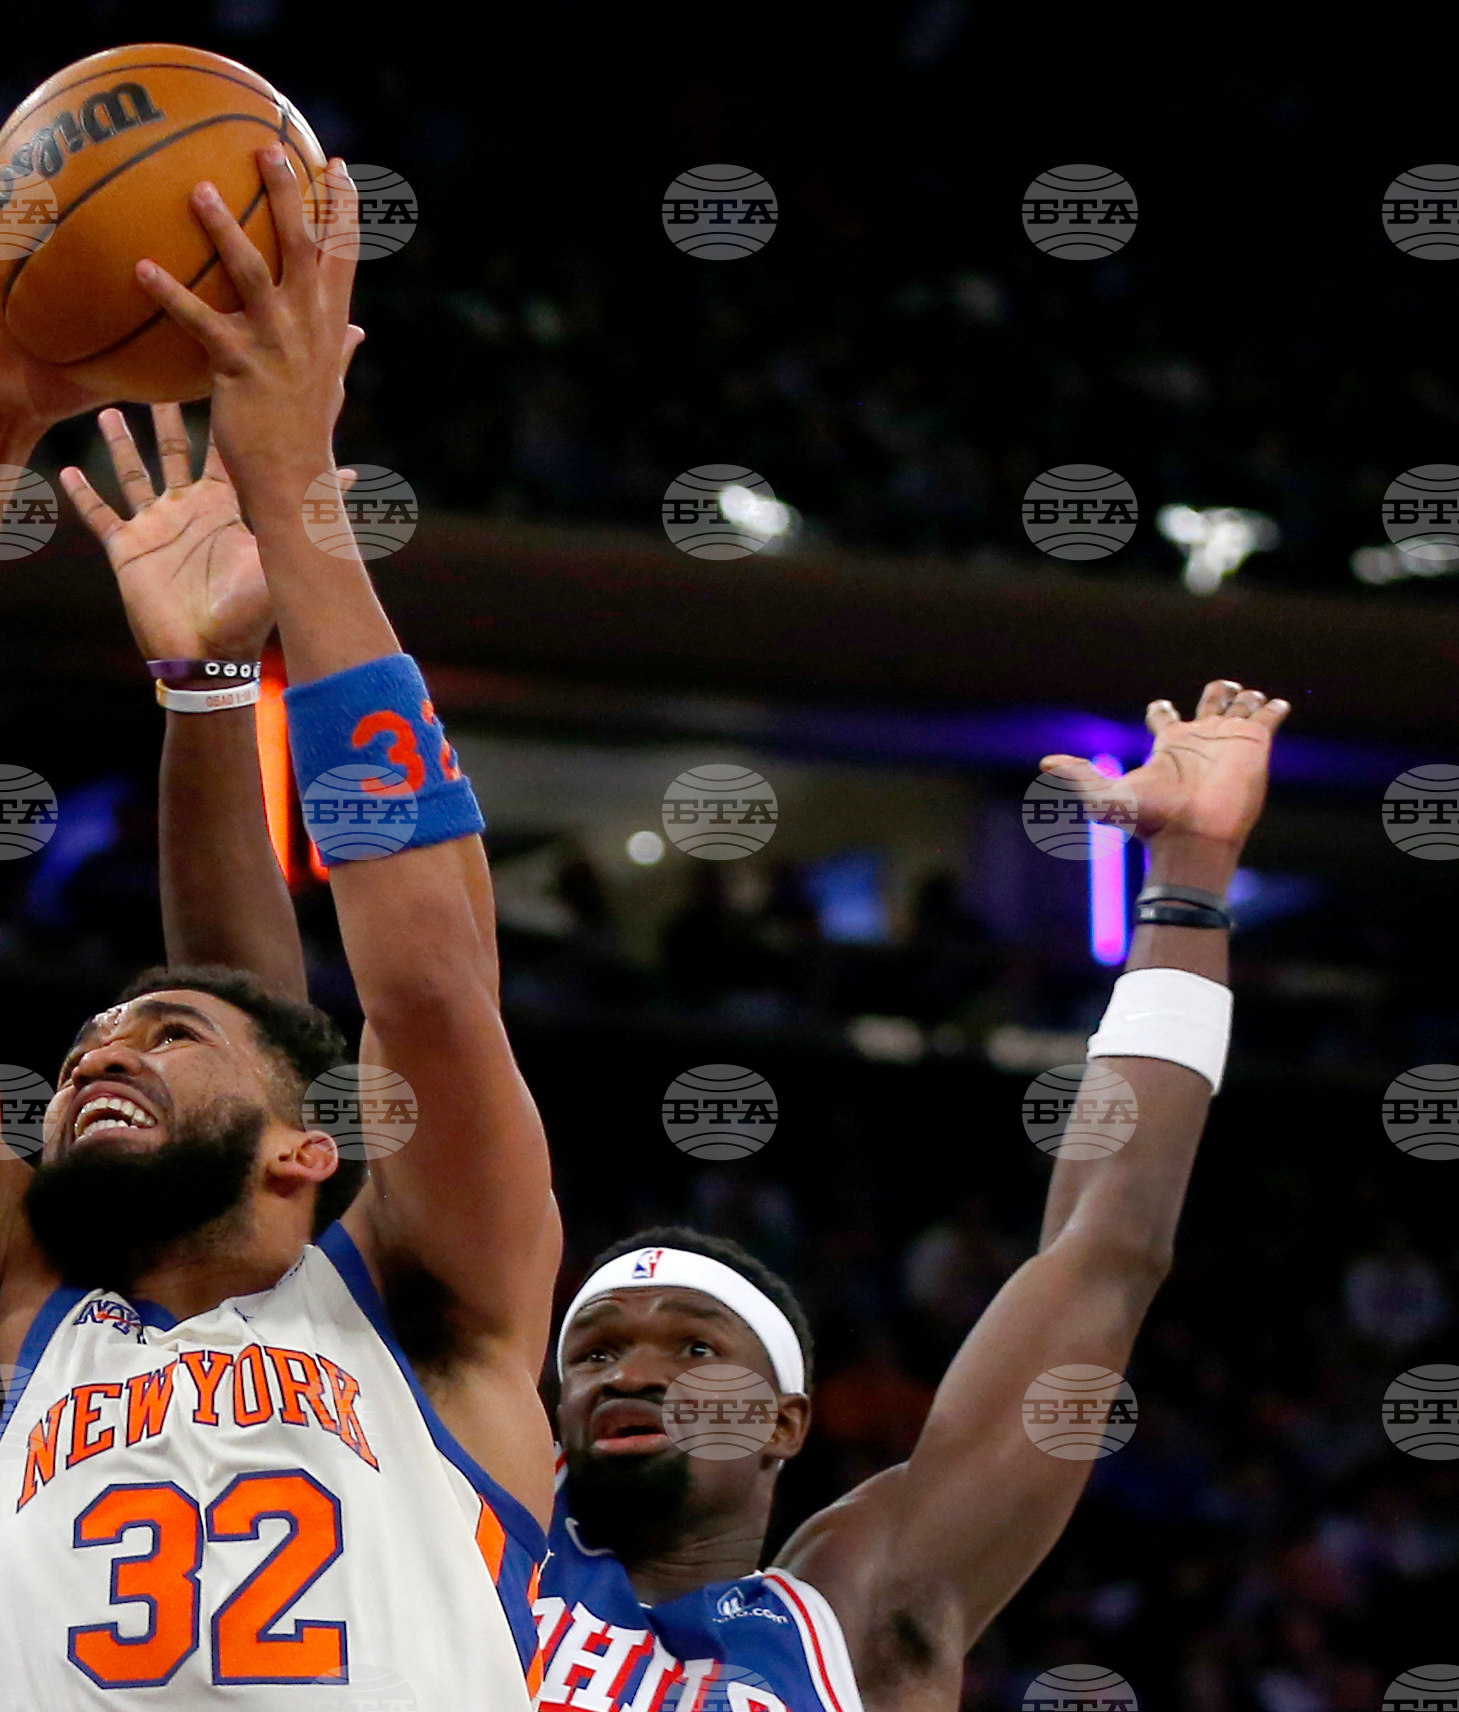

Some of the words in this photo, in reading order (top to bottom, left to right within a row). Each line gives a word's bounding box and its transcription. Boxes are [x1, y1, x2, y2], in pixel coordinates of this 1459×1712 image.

[74, 1299, 147, 1345] NY
[17, 1360, 178, 1513] NEW
[179, 1343, 380, 1472] YORK
[68, 1468, 349, 1690] 32
